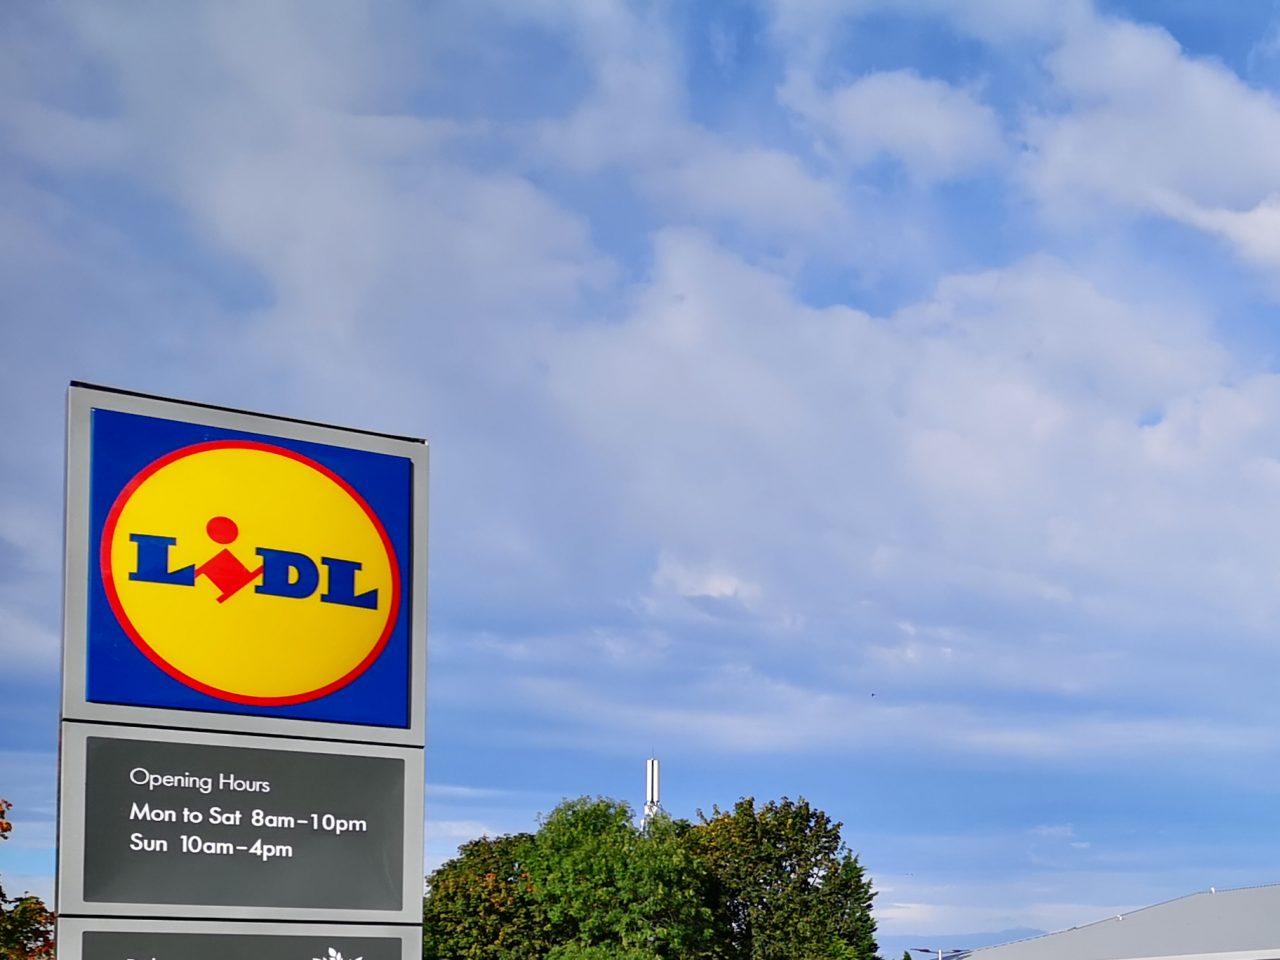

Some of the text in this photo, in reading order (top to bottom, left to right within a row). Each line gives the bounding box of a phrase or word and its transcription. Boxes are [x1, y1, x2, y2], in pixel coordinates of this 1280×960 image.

[129, 767, 271, 794] Opening Hours
[129, 802, 177, 823] Mon
[182, 807, 203, 824] to
[208, 807, 242, 826] Sat
[129, 833, 168, 852] Sun
